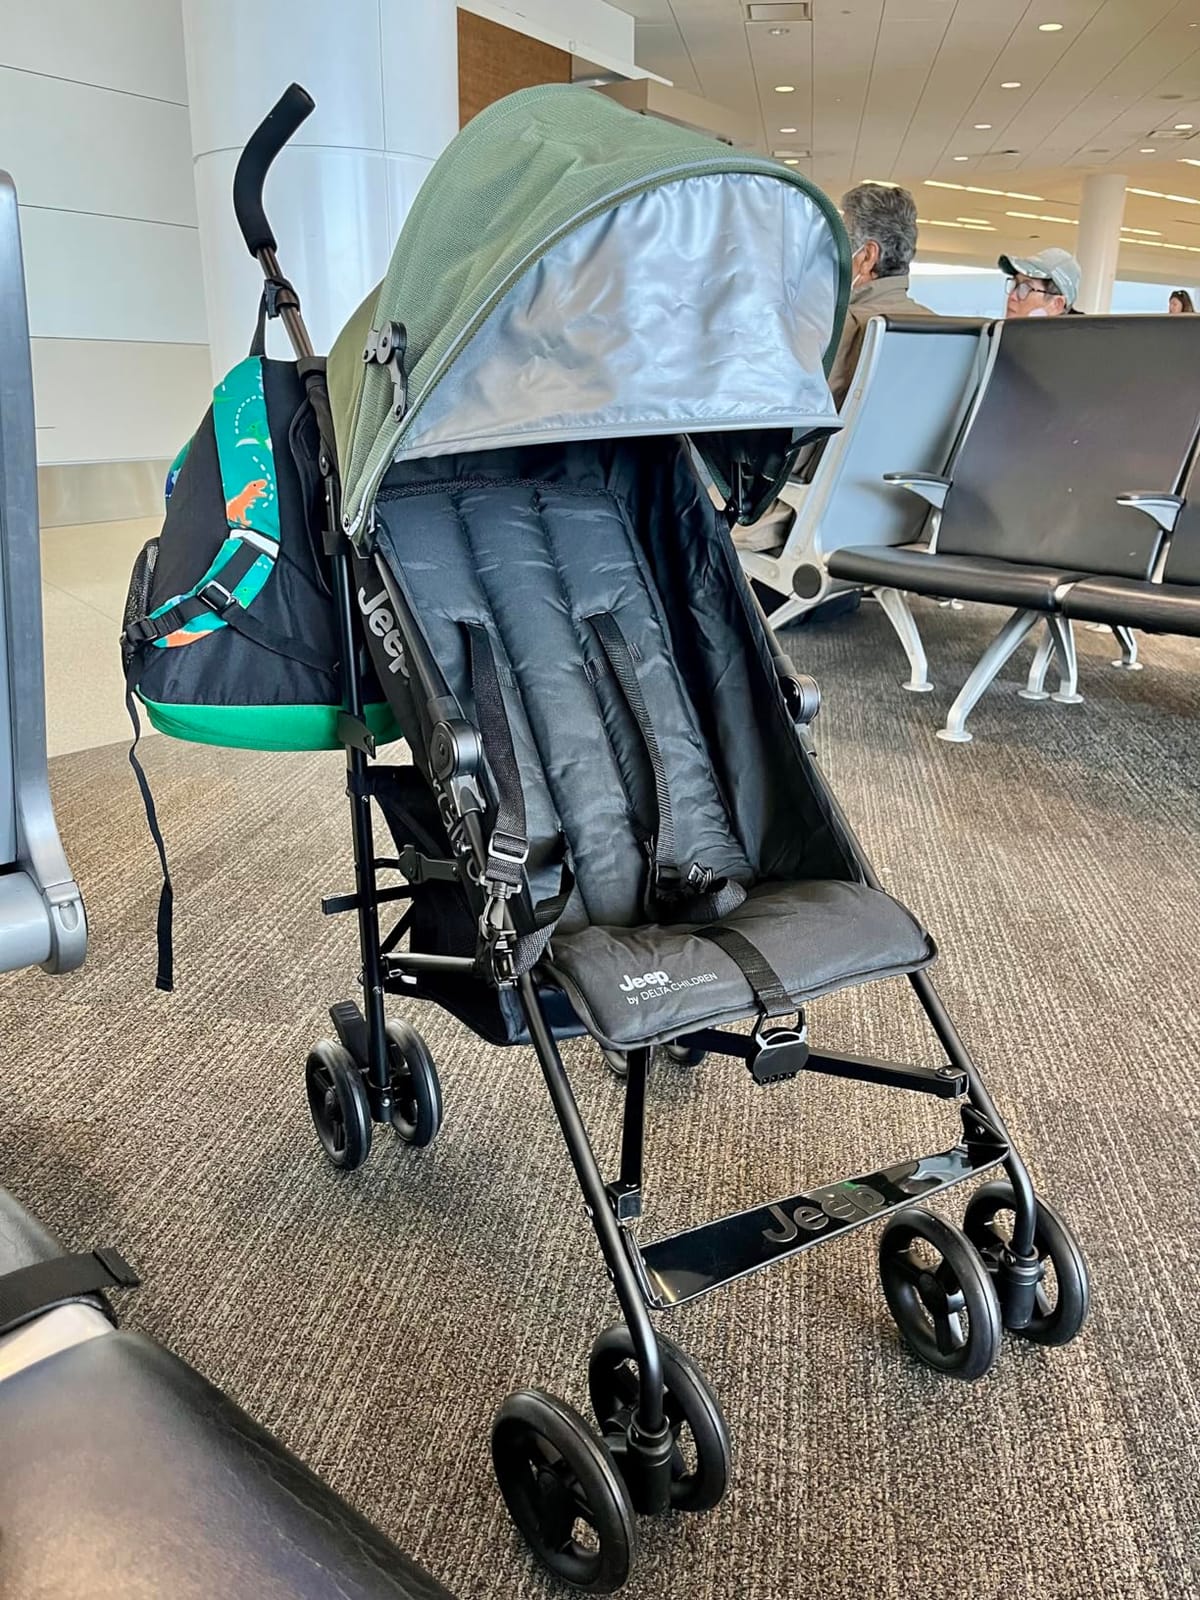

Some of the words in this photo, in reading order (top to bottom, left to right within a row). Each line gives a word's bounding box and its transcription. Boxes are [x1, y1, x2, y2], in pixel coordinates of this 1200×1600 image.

[619, 970, 670, 992] Jeep
[626, 996, 640, 1006] by
[640, 986, 673, 1001] DELTA
[670, 972, 719, 992] CHILDREN
[761, 1183, 886, 1244] Jeep
